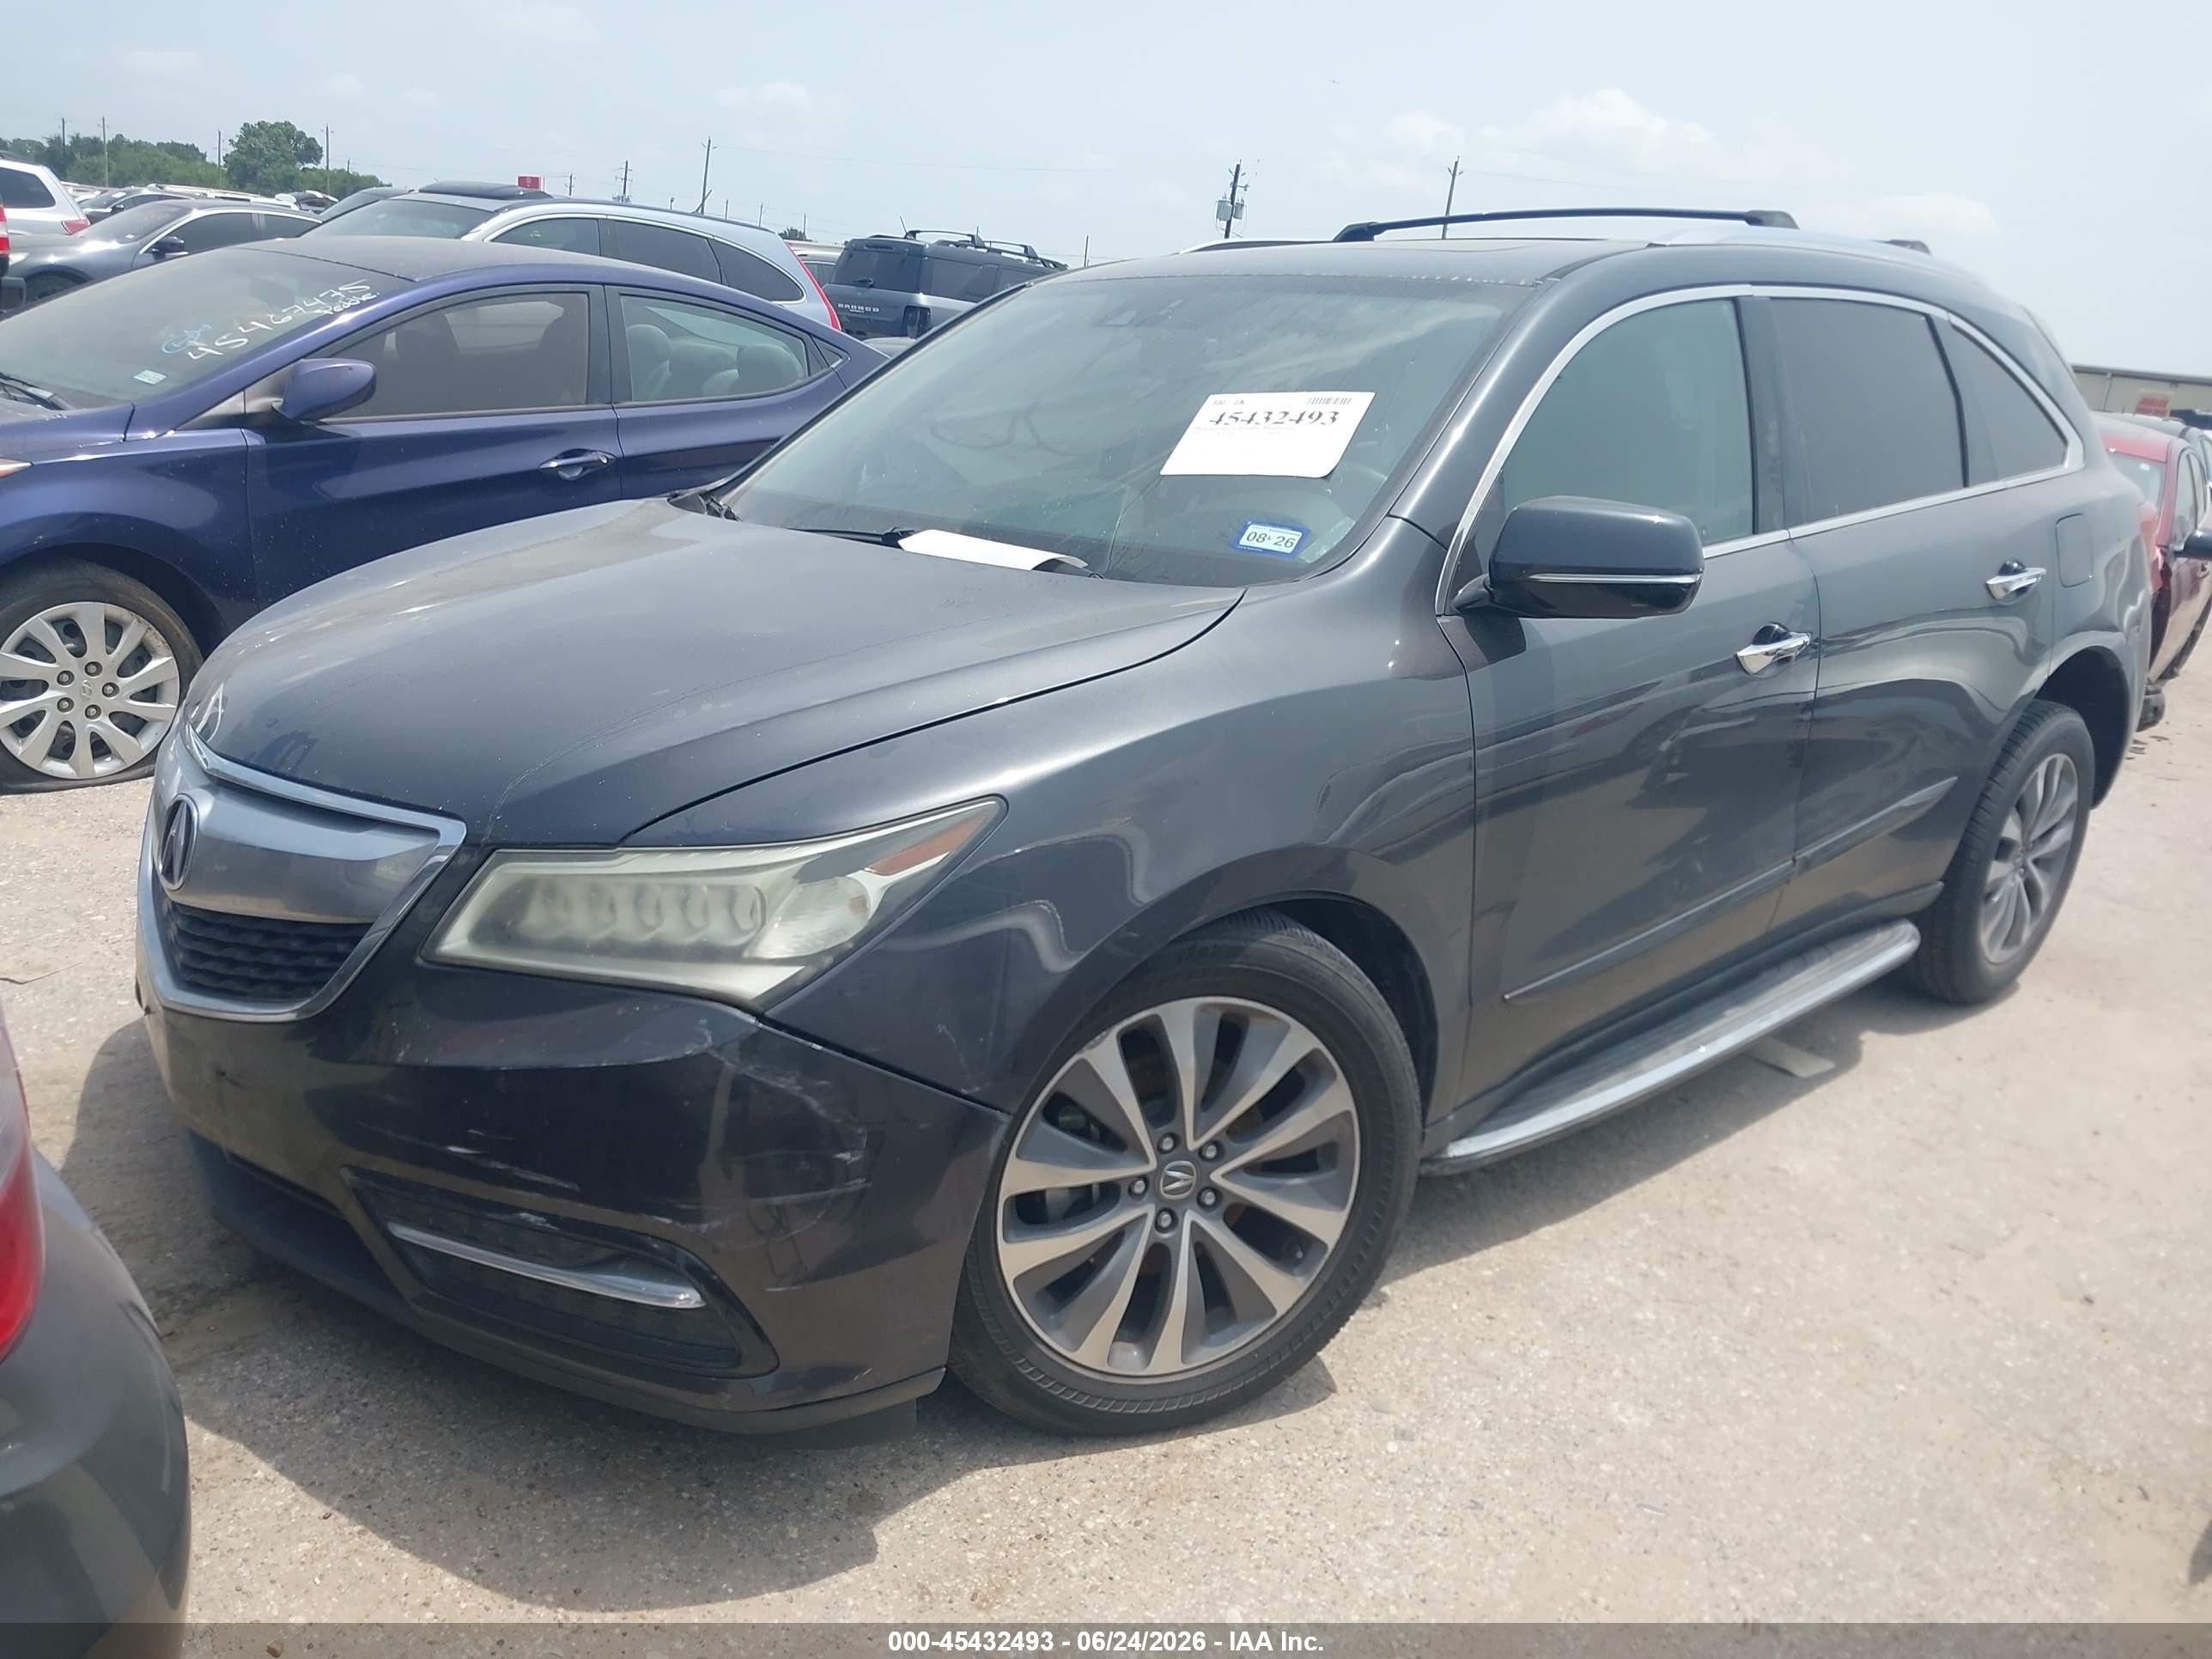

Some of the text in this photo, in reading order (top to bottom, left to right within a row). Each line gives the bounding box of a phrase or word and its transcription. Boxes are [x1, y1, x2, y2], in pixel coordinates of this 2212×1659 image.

[1209, 410, 1340, 426] 45432493
[1246, 532, 1267, 544] 08
[1273, 535, 1297, 549] 26
